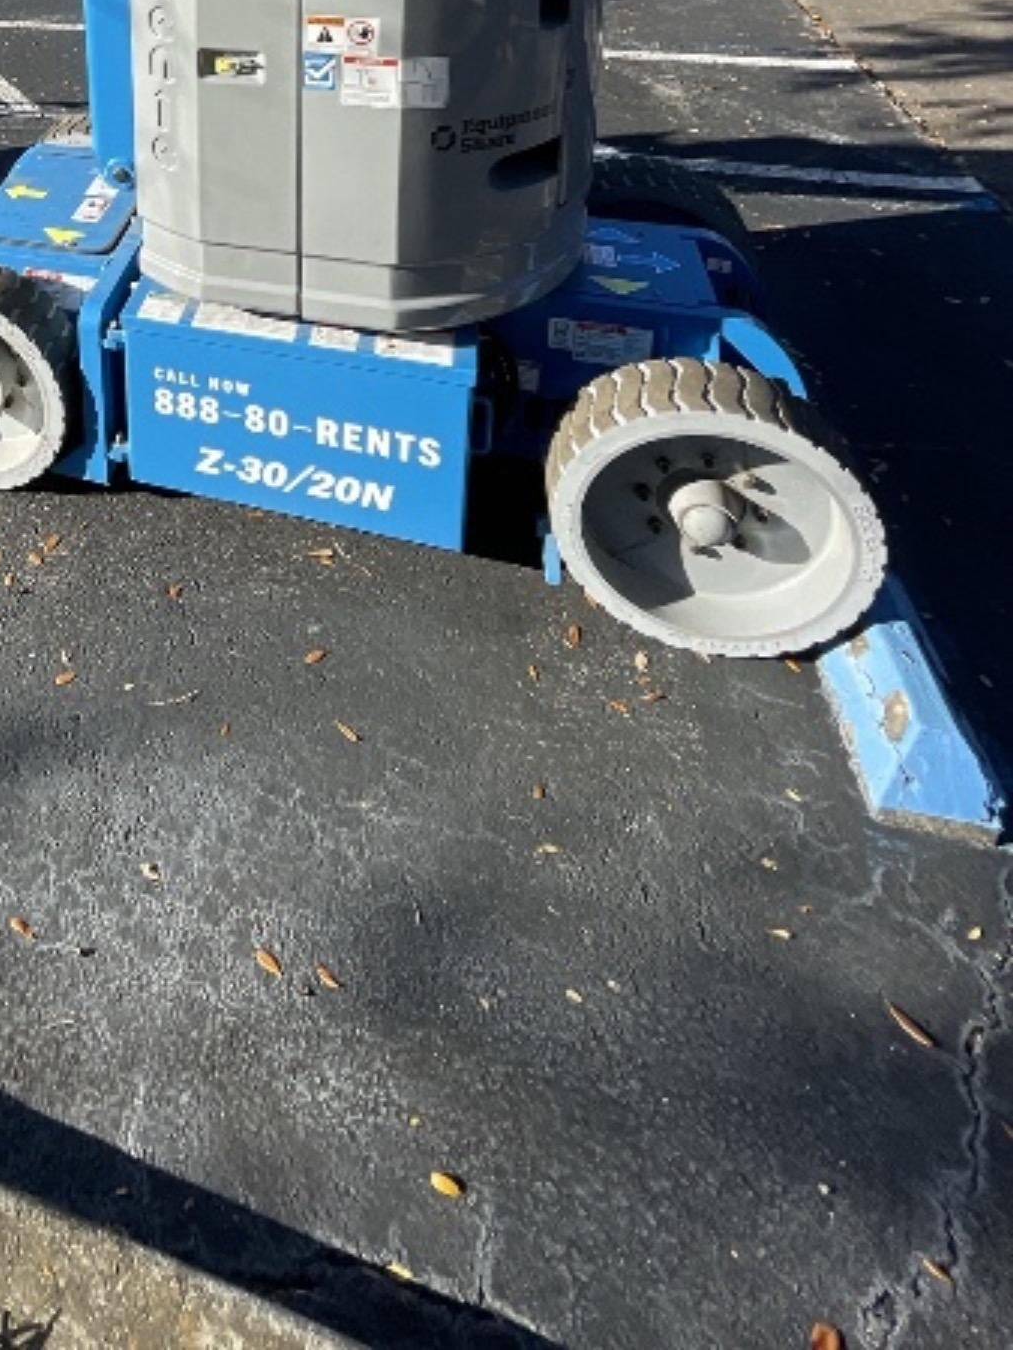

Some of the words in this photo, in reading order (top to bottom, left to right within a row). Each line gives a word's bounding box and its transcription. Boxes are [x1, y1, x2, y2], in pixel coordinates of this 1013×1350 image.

[154, 366, 199, 388] CALL
[208, 376, 251, 397] NOW
[154, 387, 442, 468] 888-80-RENTS
[195, 446, 395, 511] Z-30/20N
